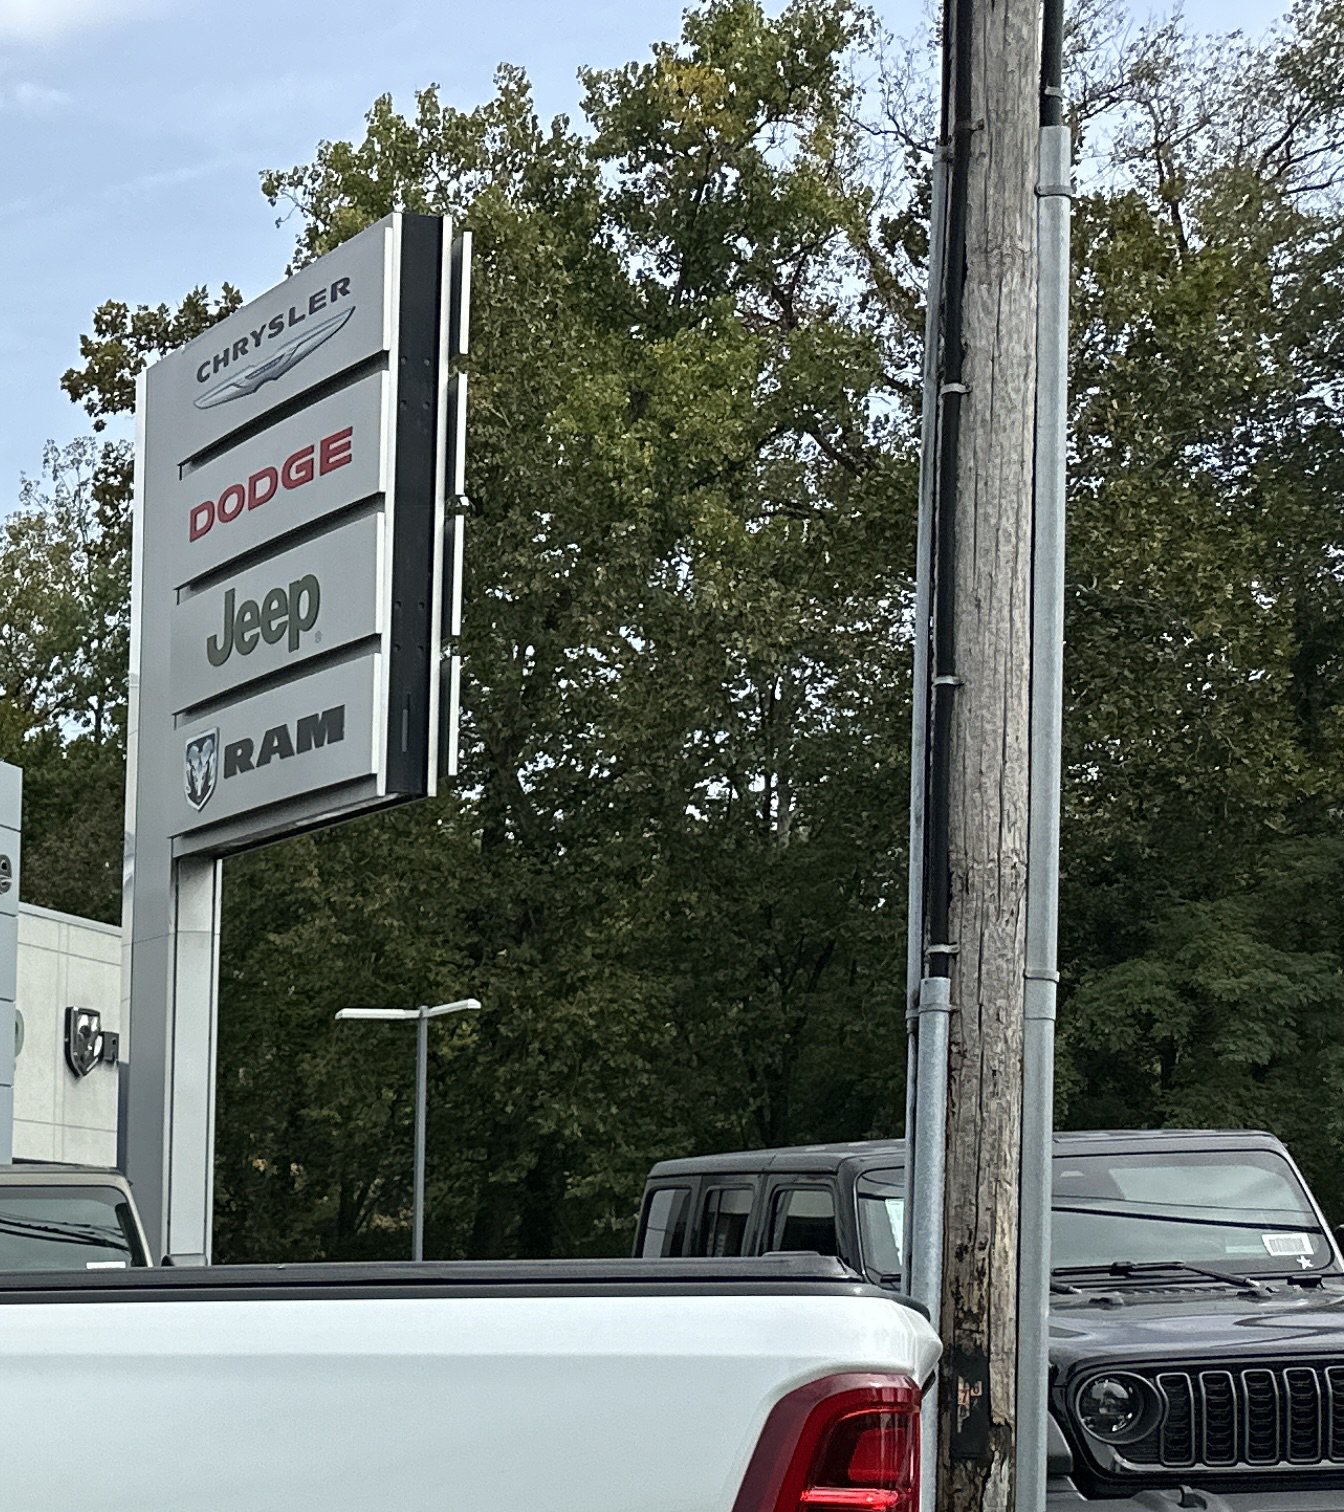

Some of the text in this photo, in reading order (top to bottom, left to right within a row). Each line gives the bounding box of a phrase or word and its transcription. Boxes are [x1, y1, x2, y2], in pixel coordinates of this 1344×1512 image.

[196, 277, 351, 384] CHRYSLER
[189, 425, 353, 543] DODGE
[207, 574, 321, 667] Jeep
[223, 704, 345, 779] RAM
